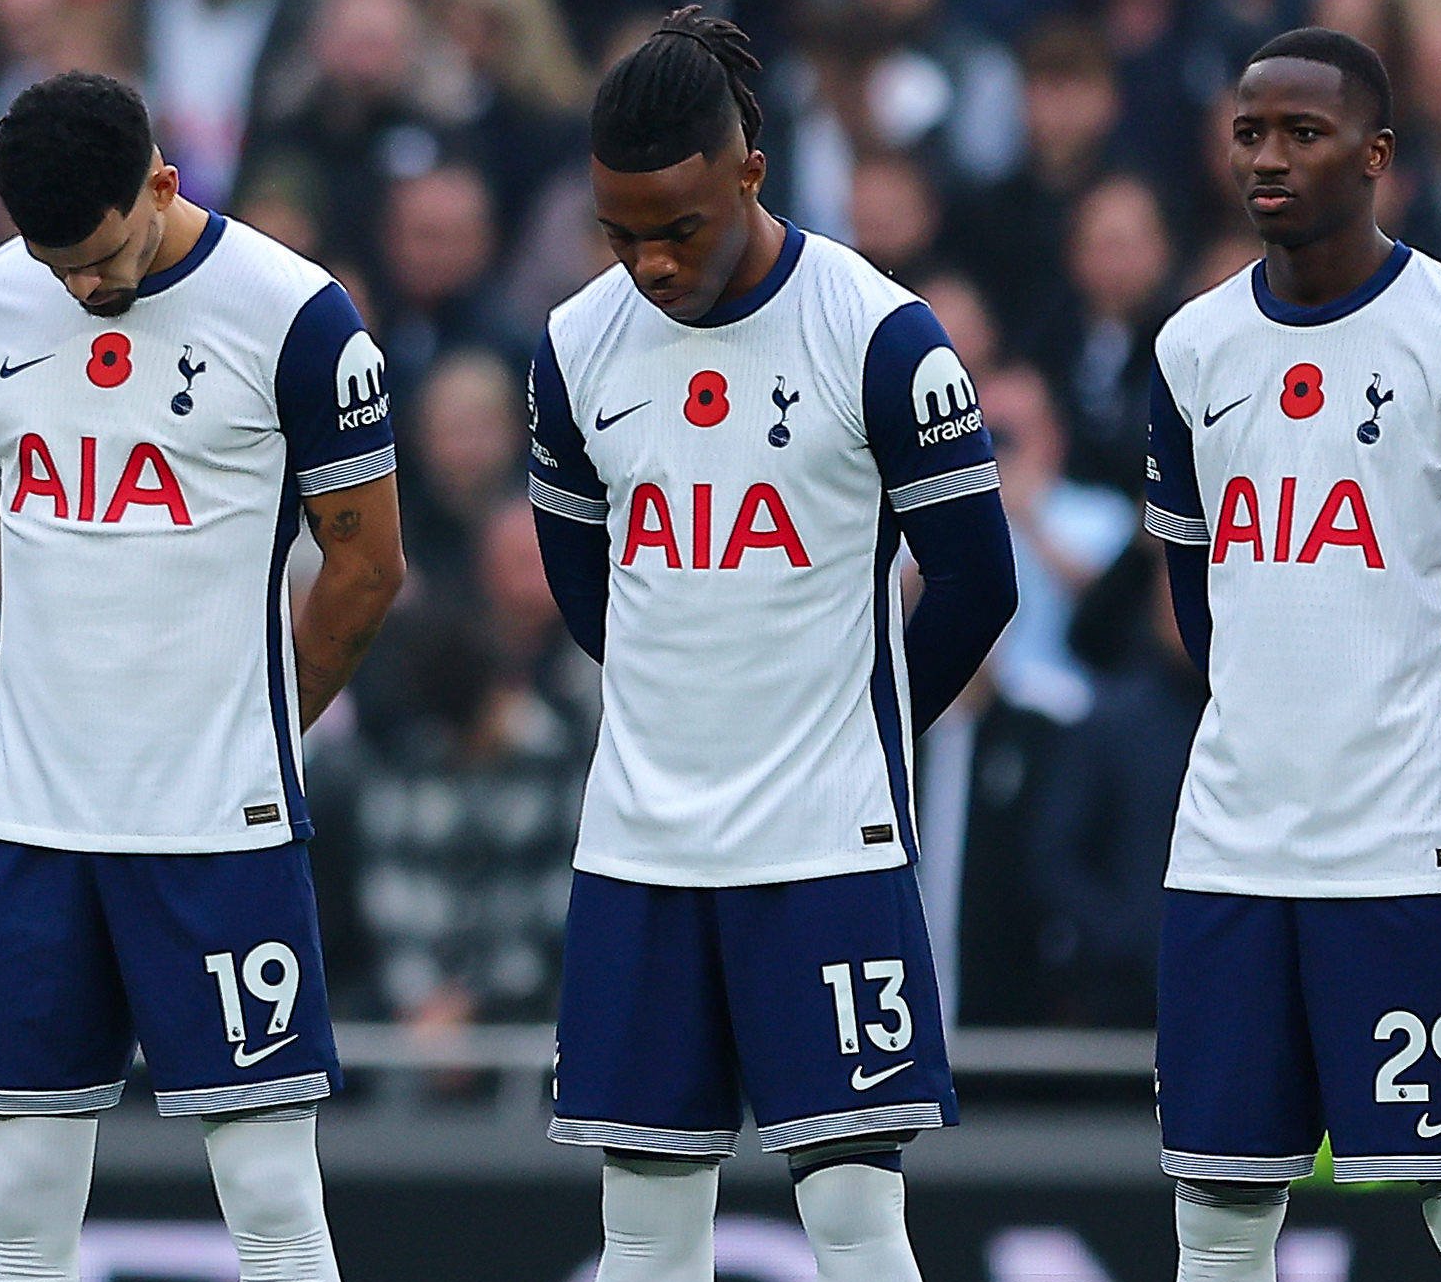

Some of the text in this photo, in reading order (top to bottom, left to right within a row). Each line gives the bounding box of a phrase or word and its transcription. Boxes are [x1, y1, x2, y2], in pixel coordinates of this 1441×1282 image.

[12, 435, 191, 525] AIA
[1213, 478, 1384, 568] AIA
[622, 484, 811, 569] AIA
[205, 942, 299, 1041] 19
[823, 960, 911, 1054] 13
